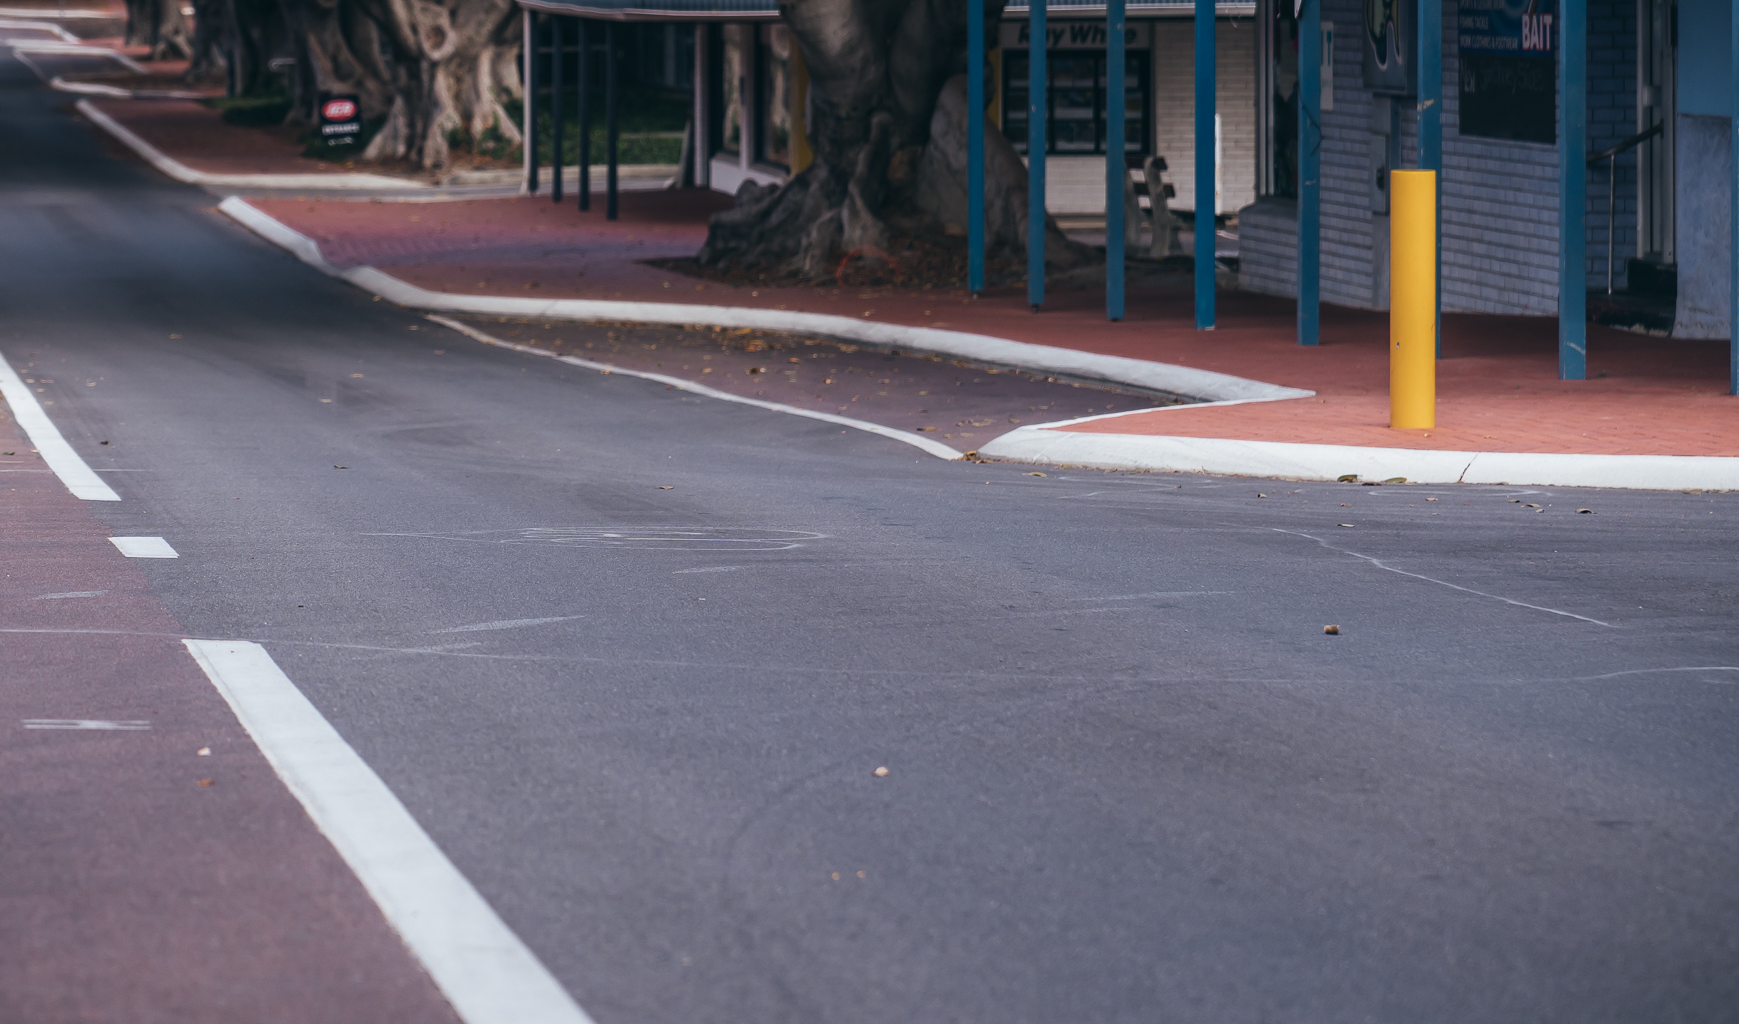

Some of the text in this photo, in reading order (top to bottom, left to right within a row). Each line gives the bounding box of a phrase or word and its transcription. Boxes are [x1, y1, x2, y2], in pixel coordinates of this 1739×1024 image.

[1018, 24, 1136, 47] Ry Whe
[1522, 13, 1553, 51] BAIT
